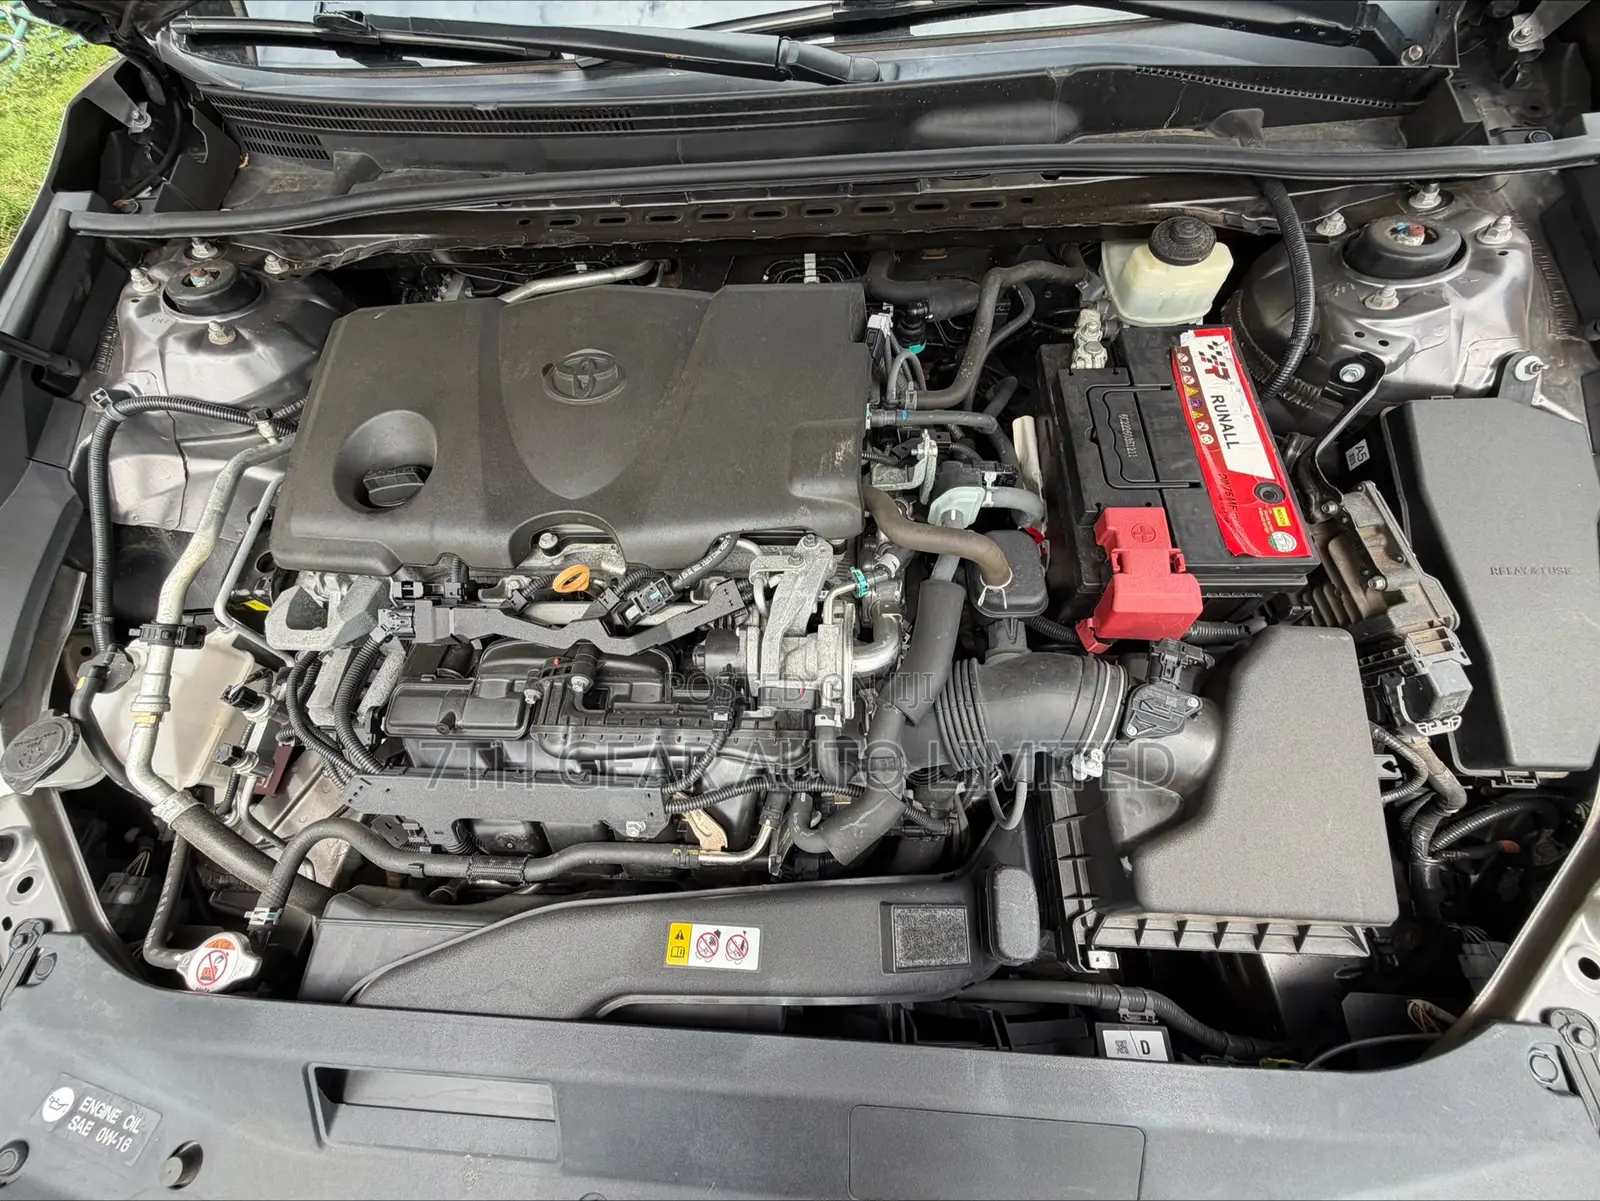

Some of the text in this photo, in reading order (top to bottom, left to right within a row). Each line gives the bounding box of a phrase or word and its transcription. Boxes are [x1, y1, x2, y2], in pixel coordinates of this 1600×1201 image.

[1210, 394, 1240, 450] RUNALL
[1354, 445, 1367, 462] A5
[1490, 566, 1527, 576] RELAY
[1530, 566, 1539, 576] &
[1140, 1040, 1151, 1055] D
[79, 1096, 144, 1135] ENGINE OIL
[67, 1115, 97, 1137] SAE
